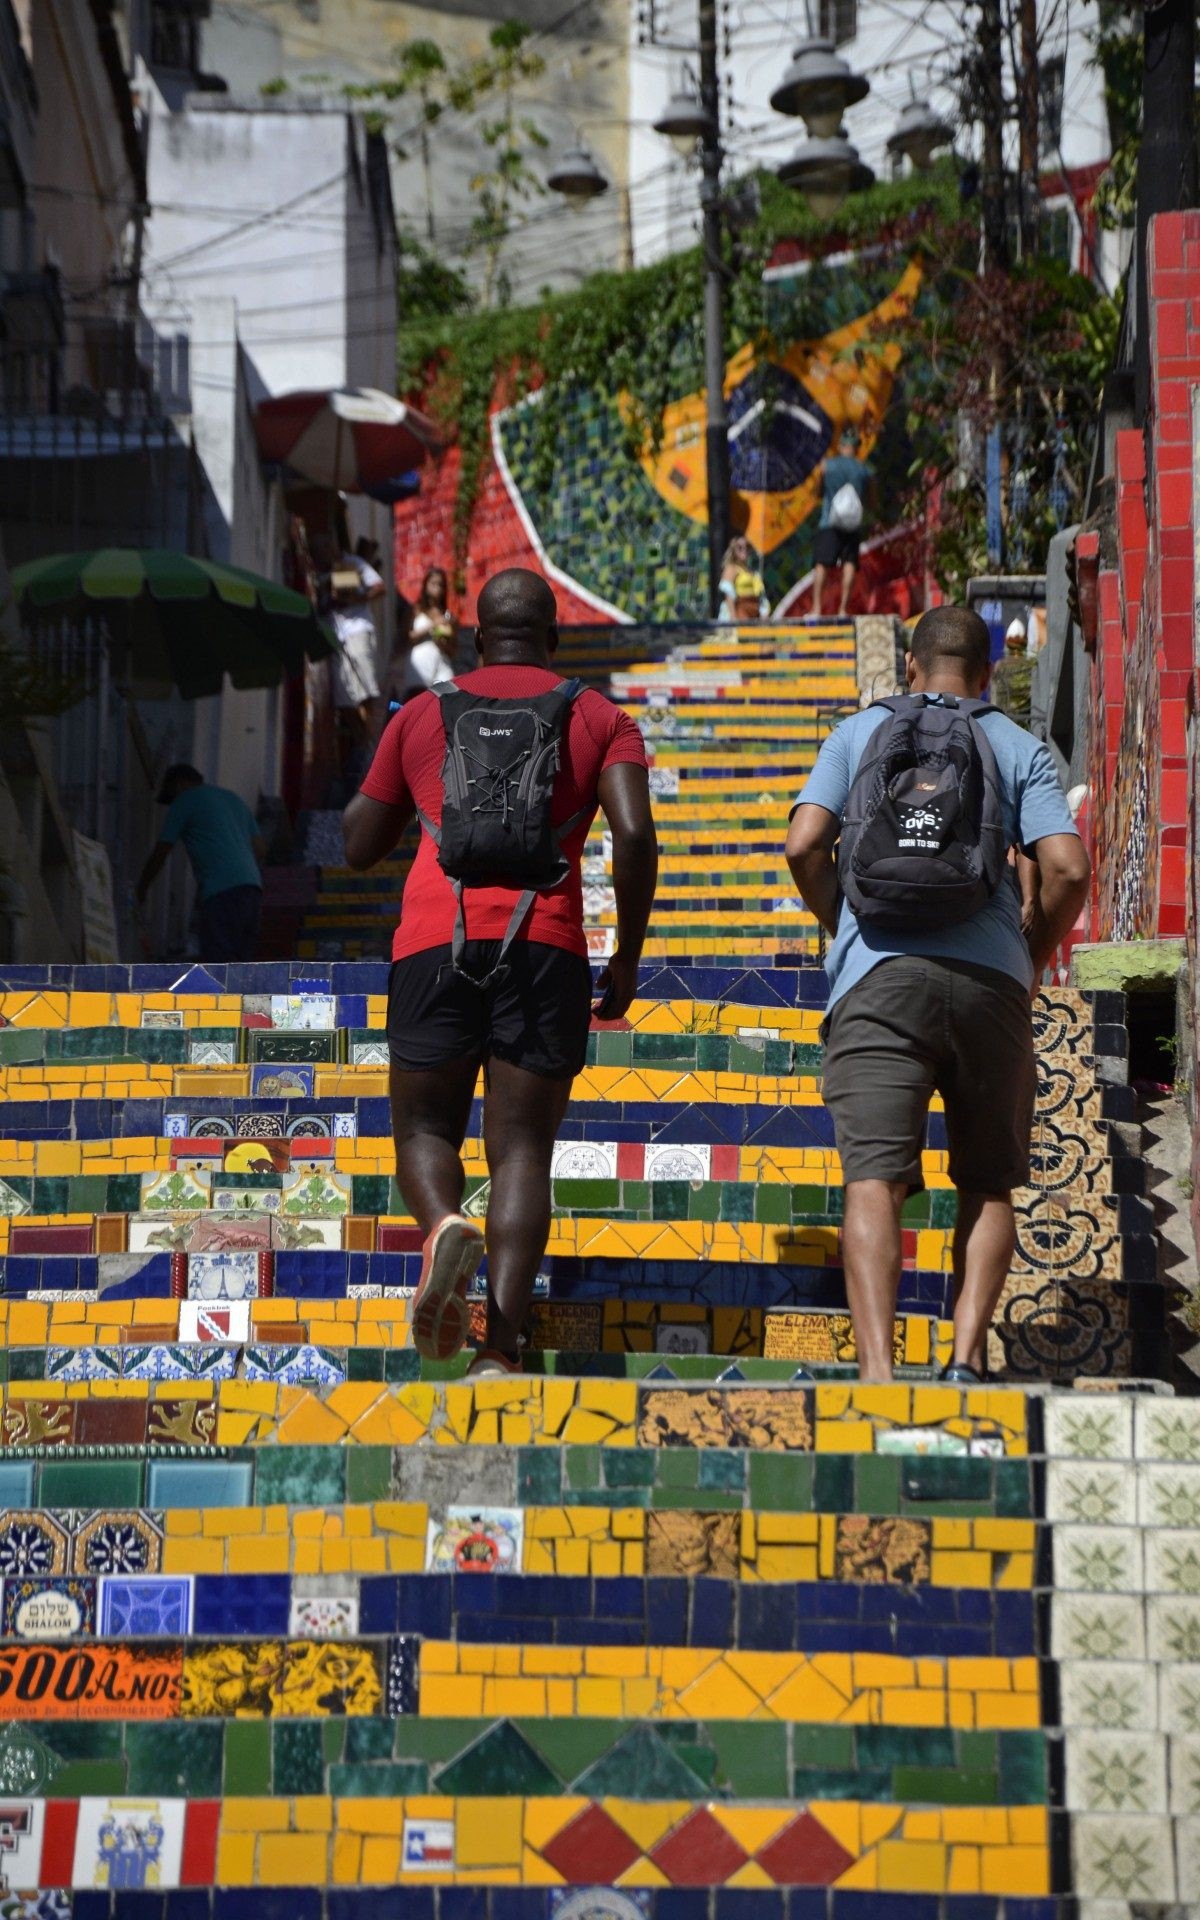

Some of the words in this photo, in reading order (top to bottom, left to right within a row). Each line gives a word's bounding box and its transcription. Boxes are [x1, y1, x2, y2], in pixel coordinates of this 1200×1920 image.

[898, 838, 916, 848] BORN
[916, 839, 926, 848] TO
[300, 996, 317, 1004] NEW
[783, 1314, 828, 1328] ELENA
[29, 1599, 69, 1617] שלום
[24, 1619, 71, 1629] SHALOM
